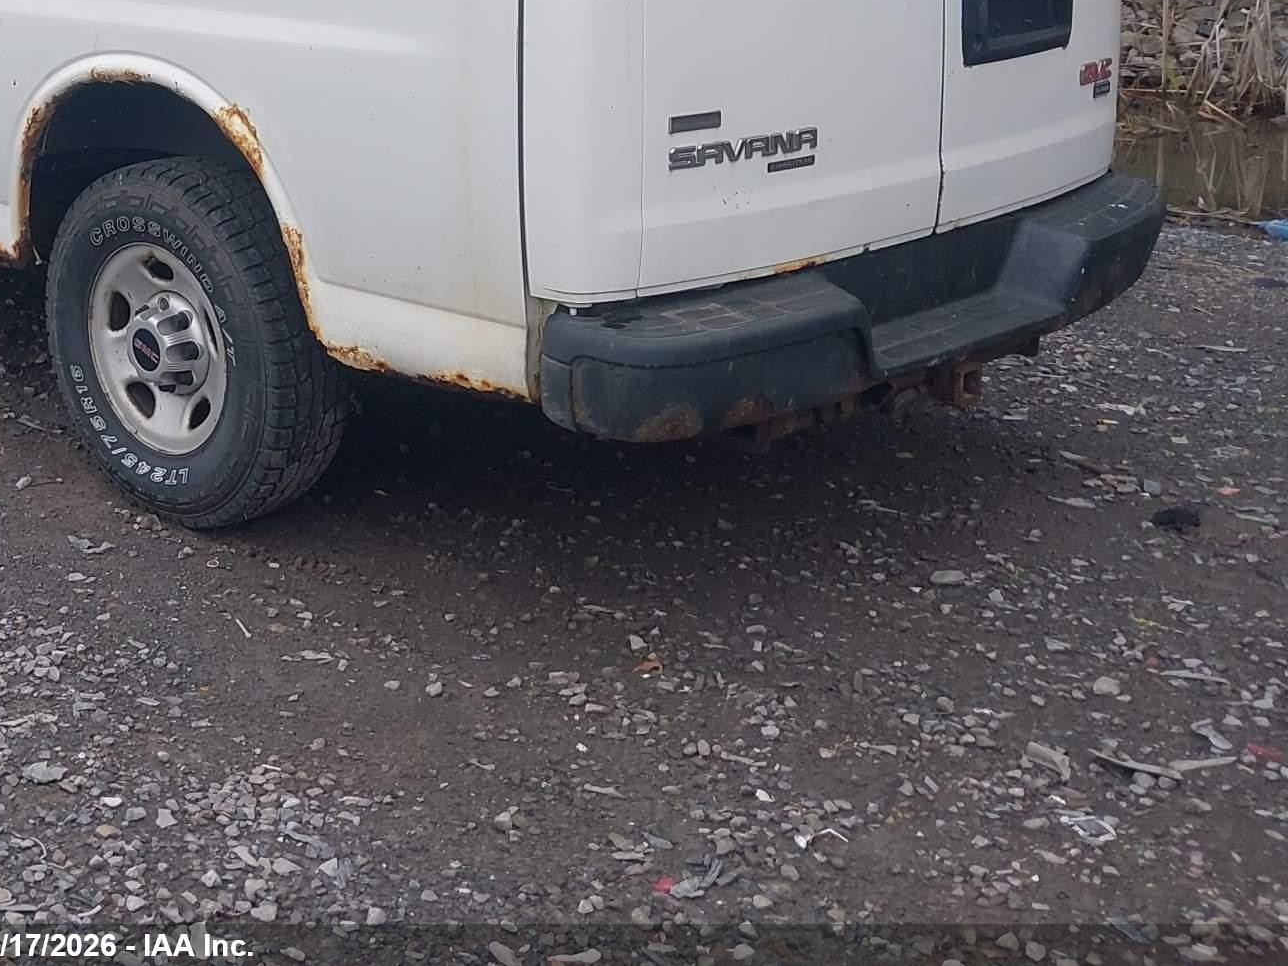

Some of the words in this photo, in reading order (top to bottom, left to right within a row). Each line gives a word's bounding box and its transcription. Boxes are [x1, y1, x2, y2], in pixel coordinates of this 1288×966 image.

[668, 126, 818, 171] SAVANA
[90, 216, 214, 294] CROSSWIND
[70, 365, 189, 485] LT245/75R16
